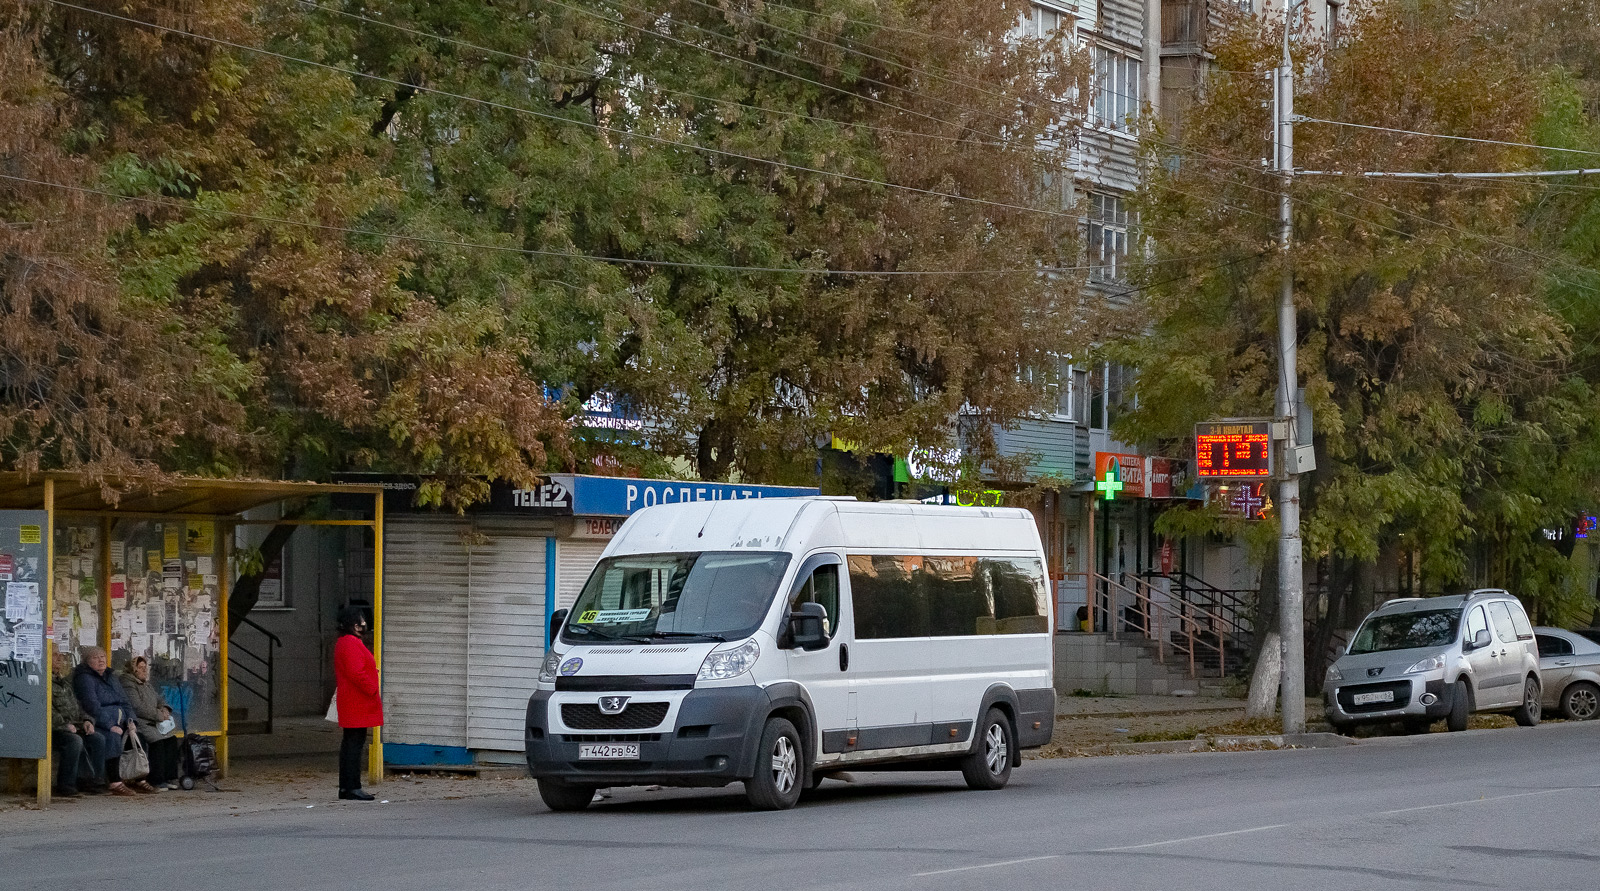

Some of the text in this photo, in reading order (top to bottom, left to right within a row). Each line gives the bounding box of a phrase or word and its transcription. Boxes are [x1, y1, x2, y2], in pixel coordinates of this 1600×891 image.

[1223, 425, 1253, 434] КВАРТАЛ
[1122, 457, 1141, 466] АПТЕКА
[1121, 467, 1142, 483] ВИТА
[512, 485, 568, 508] TELE2
[582, 611, 597, 621] 46
[585, 745, 636, 756] Т442РВ 62
